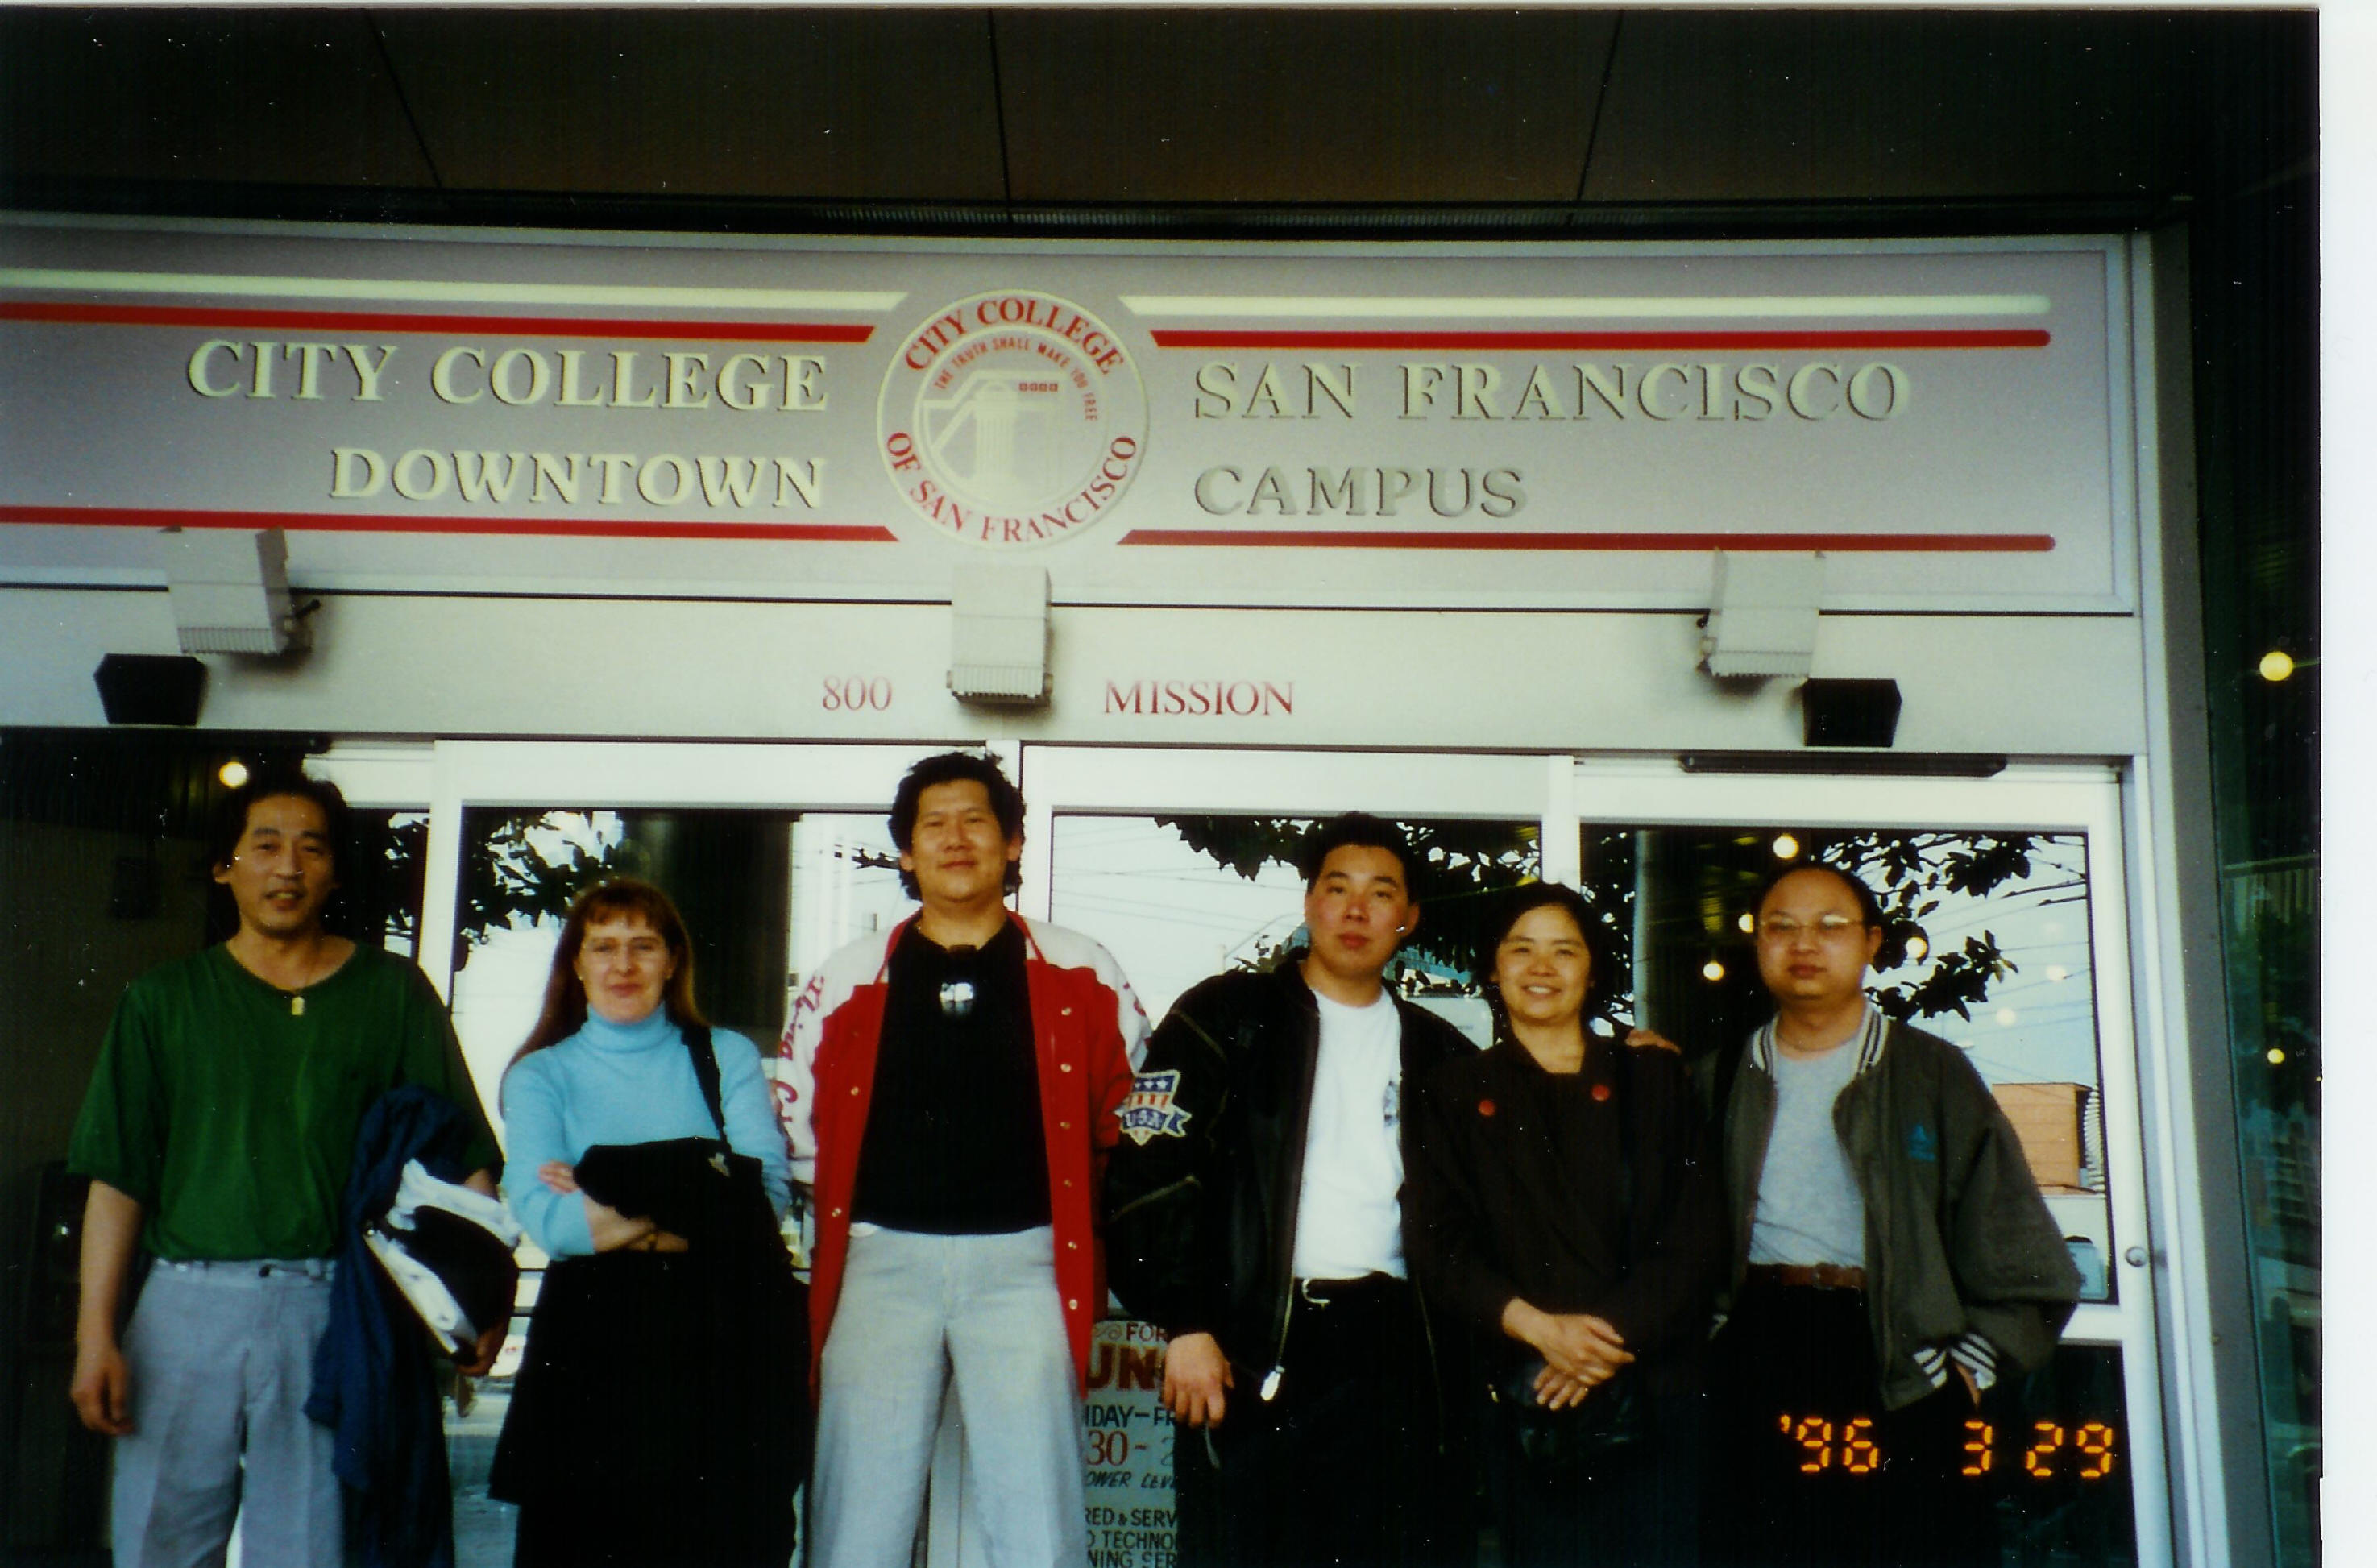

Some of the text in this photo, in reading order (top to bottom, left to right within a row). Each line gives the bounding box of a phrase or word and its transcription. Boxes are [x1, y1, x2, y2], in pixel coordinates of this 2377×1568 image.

[905, 297, 1124, 375] CITY COLLEGE
[992, 337, 1030, 351] SHALL
[186, 338, 828, 413] CITY COLLEGE
[1194, 360, 1912, 423] SAN FRANCISCO
[330, 446, 826, 508] DOWNTOWN
[887, 432, 1137, 543] OF SAN FRANCISCO
[1193, 467, 1526, 520] CAMPUS
[821, 674, 1295, 715] 800 MISSION
[1126, 1110, 1162, 1128] USA
[1101, 1530, 1177, 1549] TECHNO
